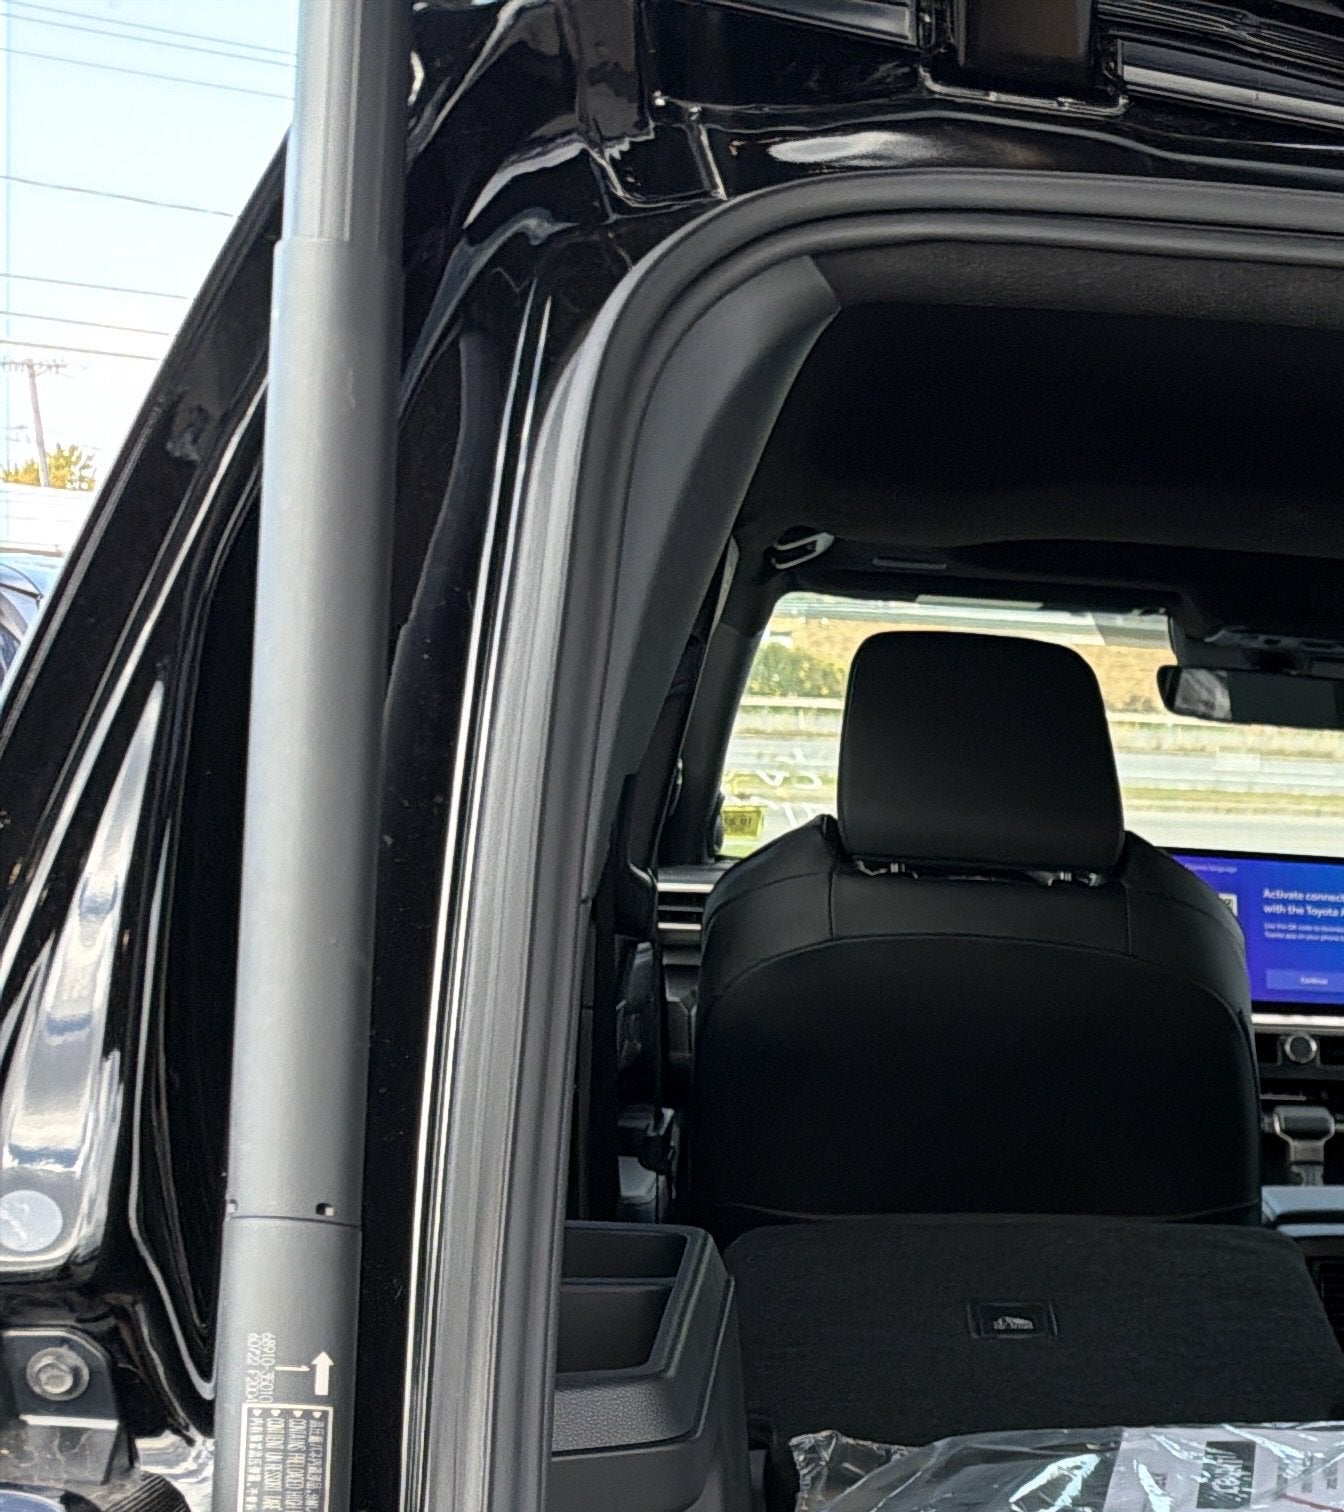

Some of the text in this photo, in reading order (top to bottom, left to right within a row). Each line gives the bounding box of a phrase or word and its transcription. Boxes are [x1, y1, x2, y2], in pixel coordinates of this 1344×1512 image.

[1263, 888, 1304, 901] Activate
[1263, 903, 1287, 915] with
[1288, 904, 1304, 916] the
[1306, 905, 1339, 919] Toyota
[288, 1419, 307, 1451] CONTAINS
[284, 1491, 303, 1509] HIGH
